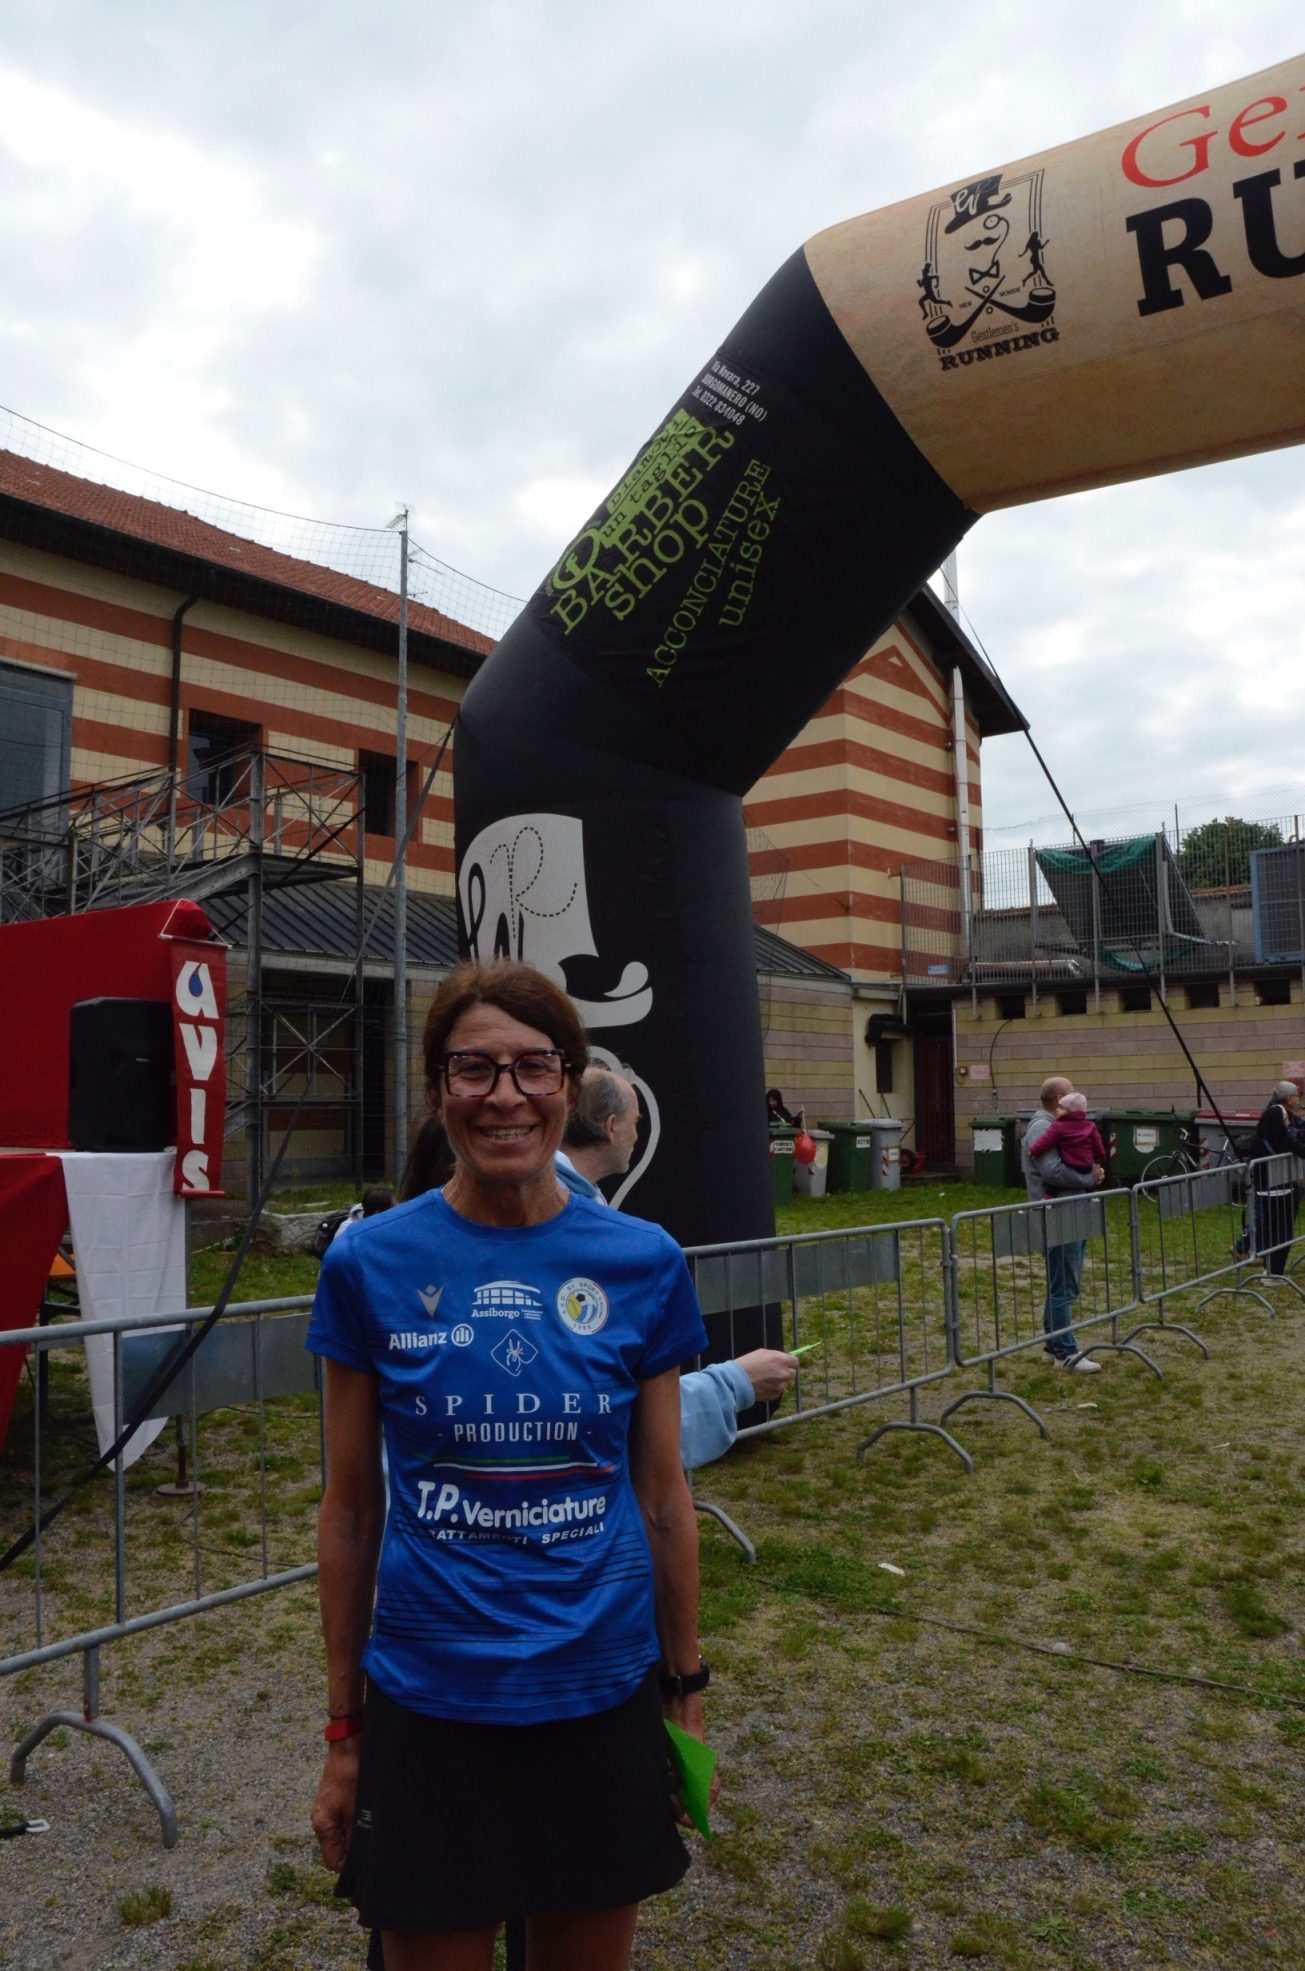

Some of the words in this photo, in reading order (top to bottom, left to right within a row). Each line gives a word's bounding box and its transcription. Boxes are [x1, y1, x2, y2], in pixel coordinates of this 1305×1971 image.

[1121, 86, 1305, 187] Ge
[1126, 160, 1305, 316] RU
[971, 321, 1019, 343] Gentlemen's
[940, 327, 1060, 371] RUNNING
[742, 379, 760, 396] 227
[713, 400, 745, 425] 834048
[745, 401, 767, 422] (NO)
[602, 511, 626, 539] un
[631, 425, 698, 504] taglio
[551, 430, 735, 635] BARBER
[604, 500, 710, 621] shop
[646, 458, 772, 688] ACCONCIATURE
[718, 492, 781, 627] unisex
[471, 1307, 520, 1320] Assiborgo
[389, 1330, 448, 1351] Allianz
[415, 1393, 612, 1416] SPIDER
[454, 1421, 578, 1442] PRODUCTION
[462, 1495, 606, 1529] Verniciature
[541, 1523, 605, 1544] SPECIALI
